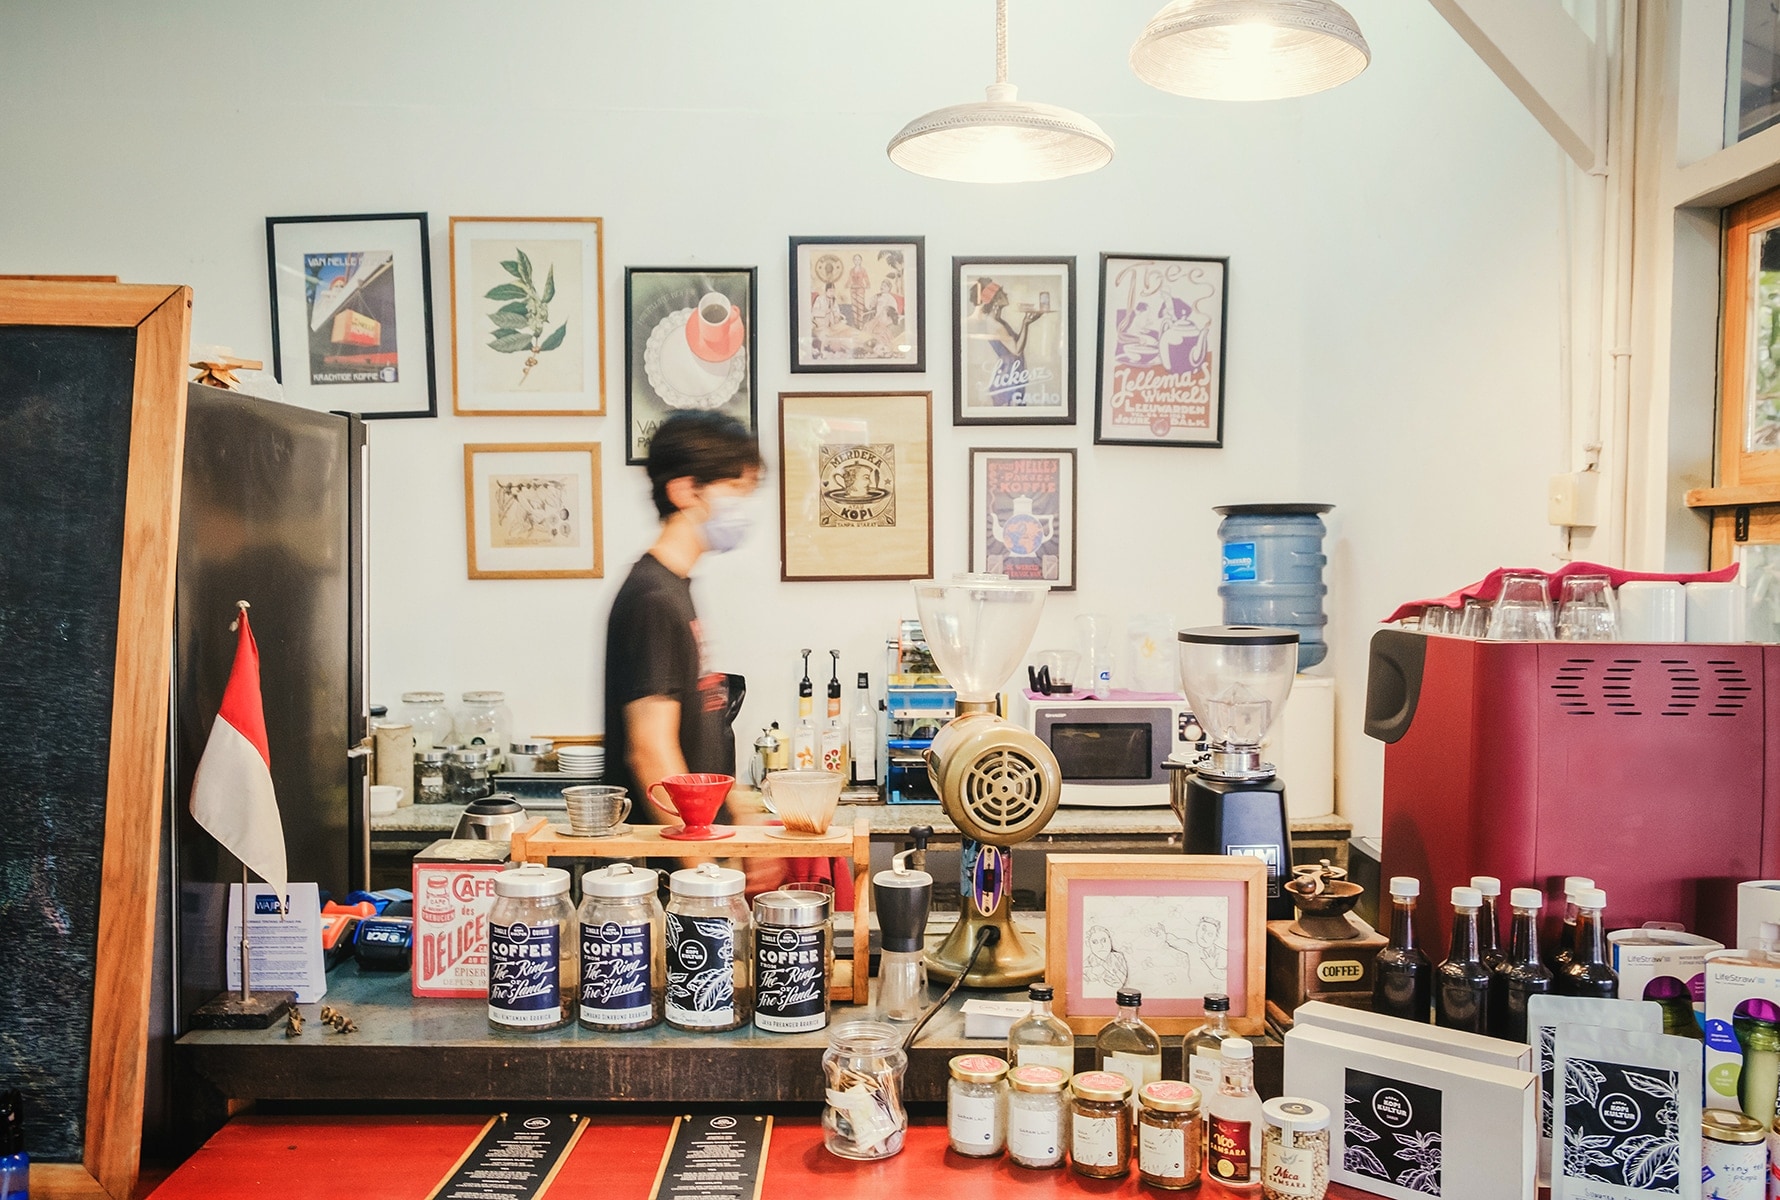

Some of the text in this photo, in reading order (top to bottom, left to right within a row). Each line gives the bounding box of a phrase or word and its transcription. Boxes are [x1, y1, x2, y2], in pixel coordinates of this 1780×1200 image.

[308, 257, 326, 267] VAN
[830, 450, 883, 468] MERDEKA
[841, 507, 873, 520] KOPI
[461, 905, 475, 916] des
[492, 942, 552, 957] COFFEE
[583, 941, 644, 957] COFFEE
[759, 949, 819, 965] COFFEE
[1627, 955, 1664, 963] LifeStraw
[490, 960, 556, 980] The Ring
[583, 959, 648, 980] The Ring
[1322, 965, 1360, 977] COFFEE
[759, 966, 822, 988] The Ring
[1715, 973, 1758, 983] LifeStraw
[1377, 1104, 1407, 1117] KULTUR
[1383, 1099, 1401, 1109] KOPI
[1610, 1105, 1630, 1113] KOPI
[1604, 1110, 1636, 1120] KULTUR
[1210, 1142, 1247, 1156] SAMSARA
[1273, 1165, 1299, 1181] Mica
[1723, 1164, 1748, 1174] tiny
[1269, 1175, 1306, 1188] SAMSARA
